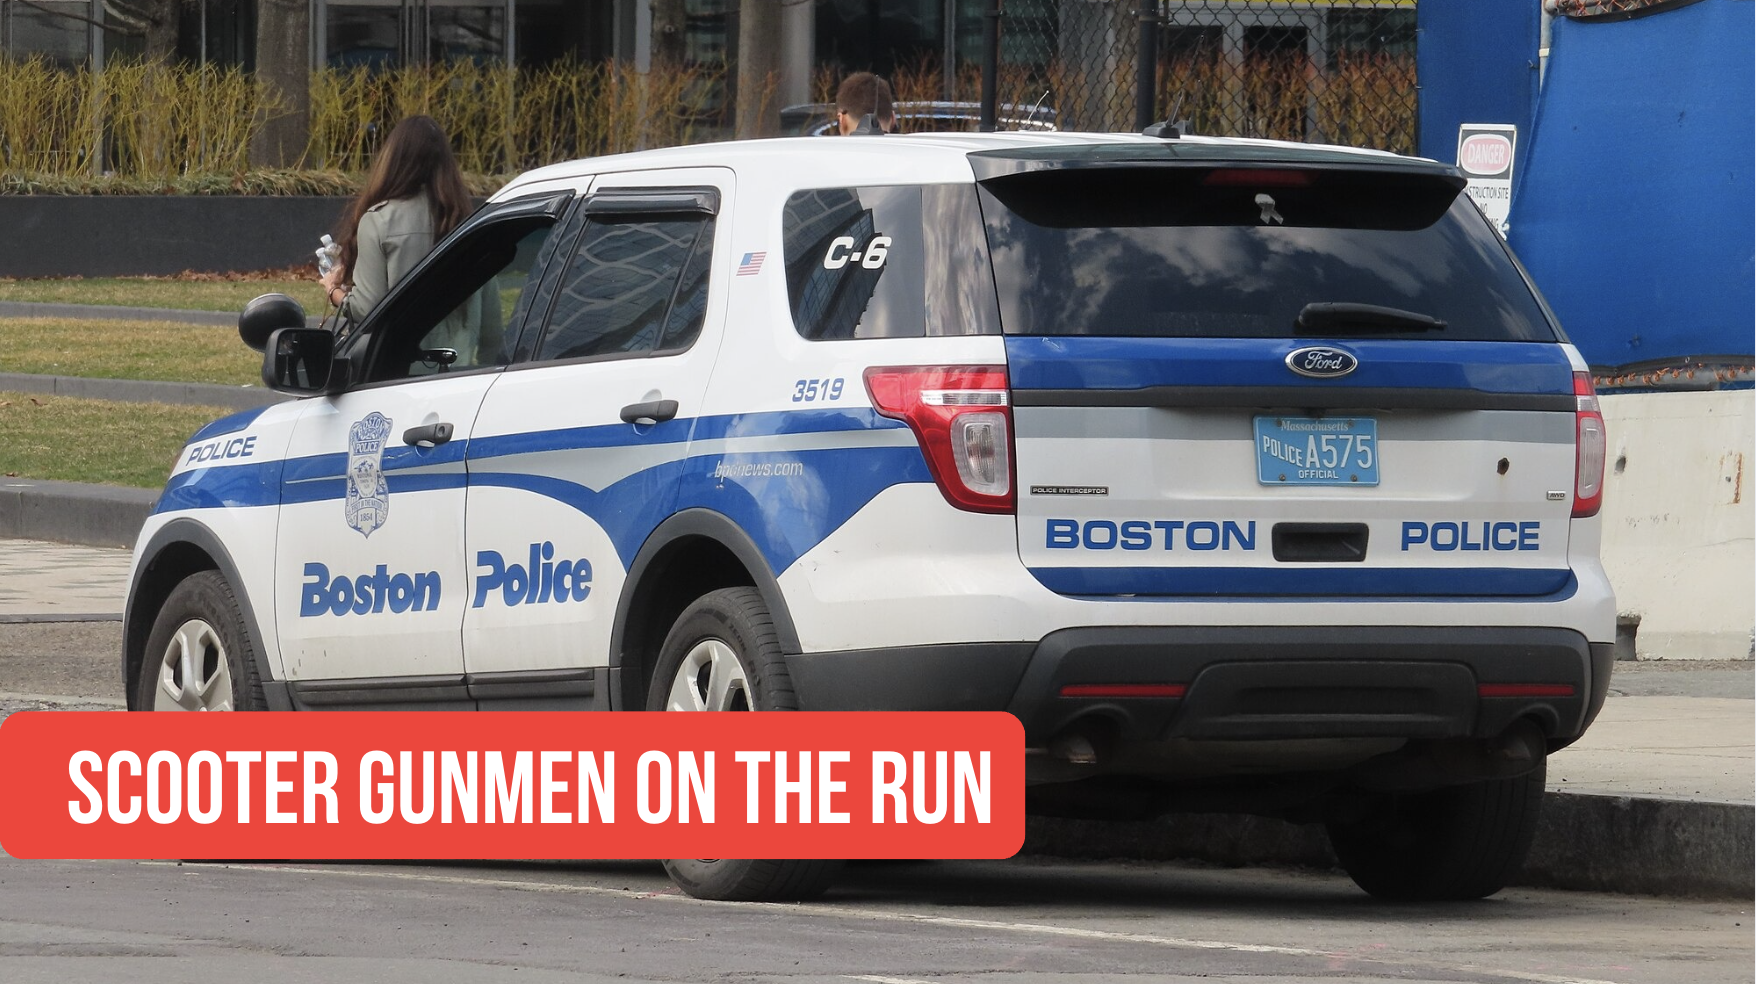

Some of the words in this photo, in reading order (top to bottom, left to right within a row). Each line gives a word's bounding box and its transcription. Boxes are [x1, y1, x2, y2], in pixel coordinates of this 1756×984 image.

[1468, 143, 1505, 164] DANGER
[1466, 186, 1497, 199] STRUCTION
[1498, 187, 1509, 200] SITE
[823, 236, 892, 269] C-6
[1304, 351, 1343, 369] Ford
[792, 378, 844, 402] 3519
[1281, 420, 1349, 432] Massachusetts
[185, 435, 257, 467] POLICE
[355, 441, 379, 454] POLICE
[1262, 435, 1302, 467] POLICE
[1305, 434, 1373, 469] A575
[714, 460, 804, 482] bpdnews.com
[1298, 469, 1339, 479] OFFICIAL
[360, 513, 373, 522] 1854
[1045, 518, 1257, 552] BOSTON
[1401, 521, 1540, 551] POLICE
[300, 562, 442, 617] Boston
[472, 540, 593, 609] Police
